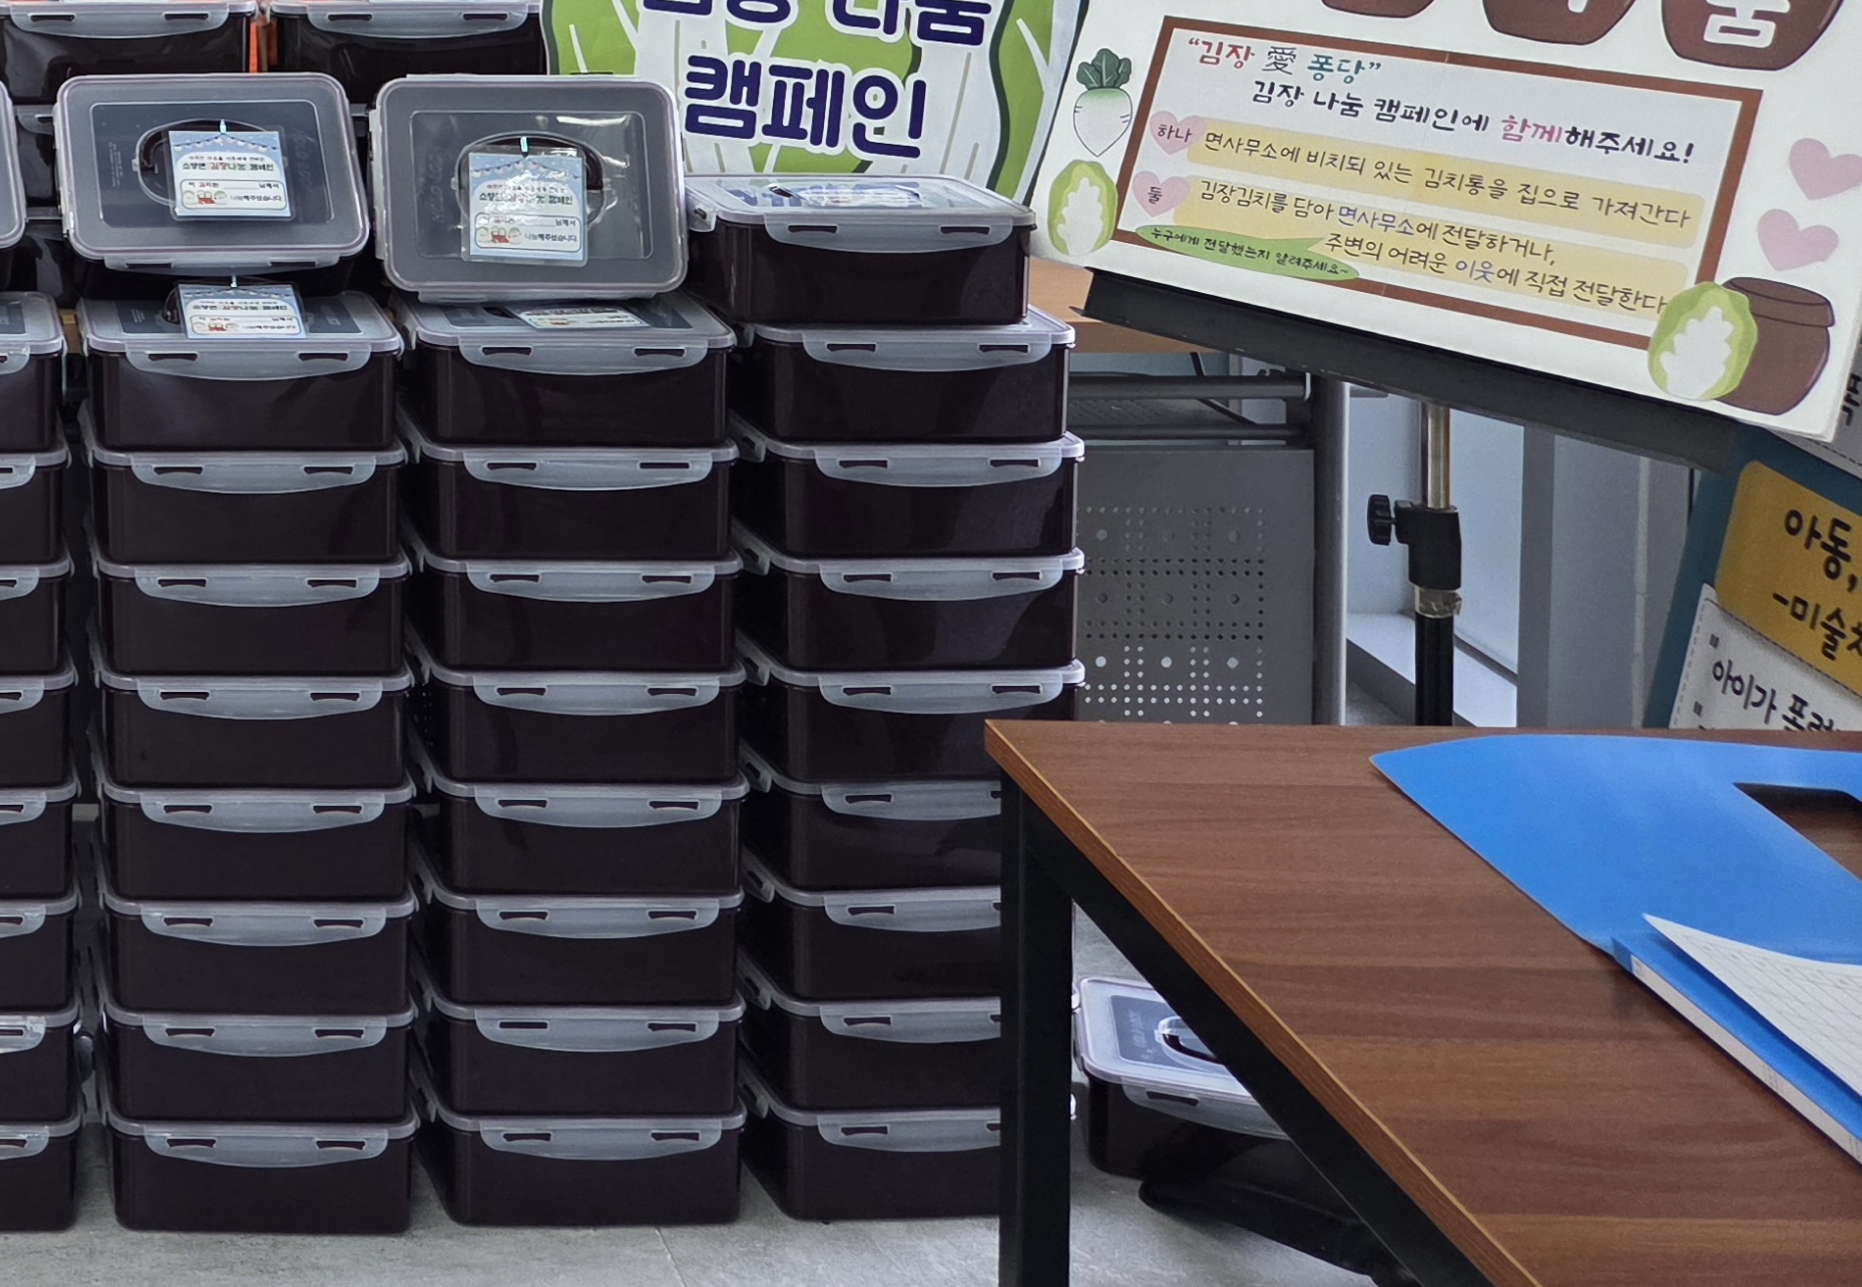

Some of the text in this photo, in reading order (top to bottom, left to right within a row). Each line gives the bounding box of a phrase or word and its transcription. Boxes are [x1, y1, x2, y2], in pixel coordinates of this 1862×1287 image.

[1188, 37, 1382, 85] “김장 愛 퐁당”
[684, 54, 928, 159] 캠페인
[1252, 80, 1695, 164] 김장 나눔 캠페인에 함께해주세요!
[1157, 123, 1692, 230] 하나 면사무소에 비치되 있는 김치통을 집으로 가져간다
[1146, 179, 1557, 266] 둘 김장김치를 담아 면사무소에 전달하거나,
[1150, 226, 1200, 247] 누구에게
[1203, 236, 1271, 261] 전달했는지
[1324, 231, 1668, 315] 주변의 어려운 이웃에 직접 전달한다
[1711, 658, 1778, 726] 아이가
